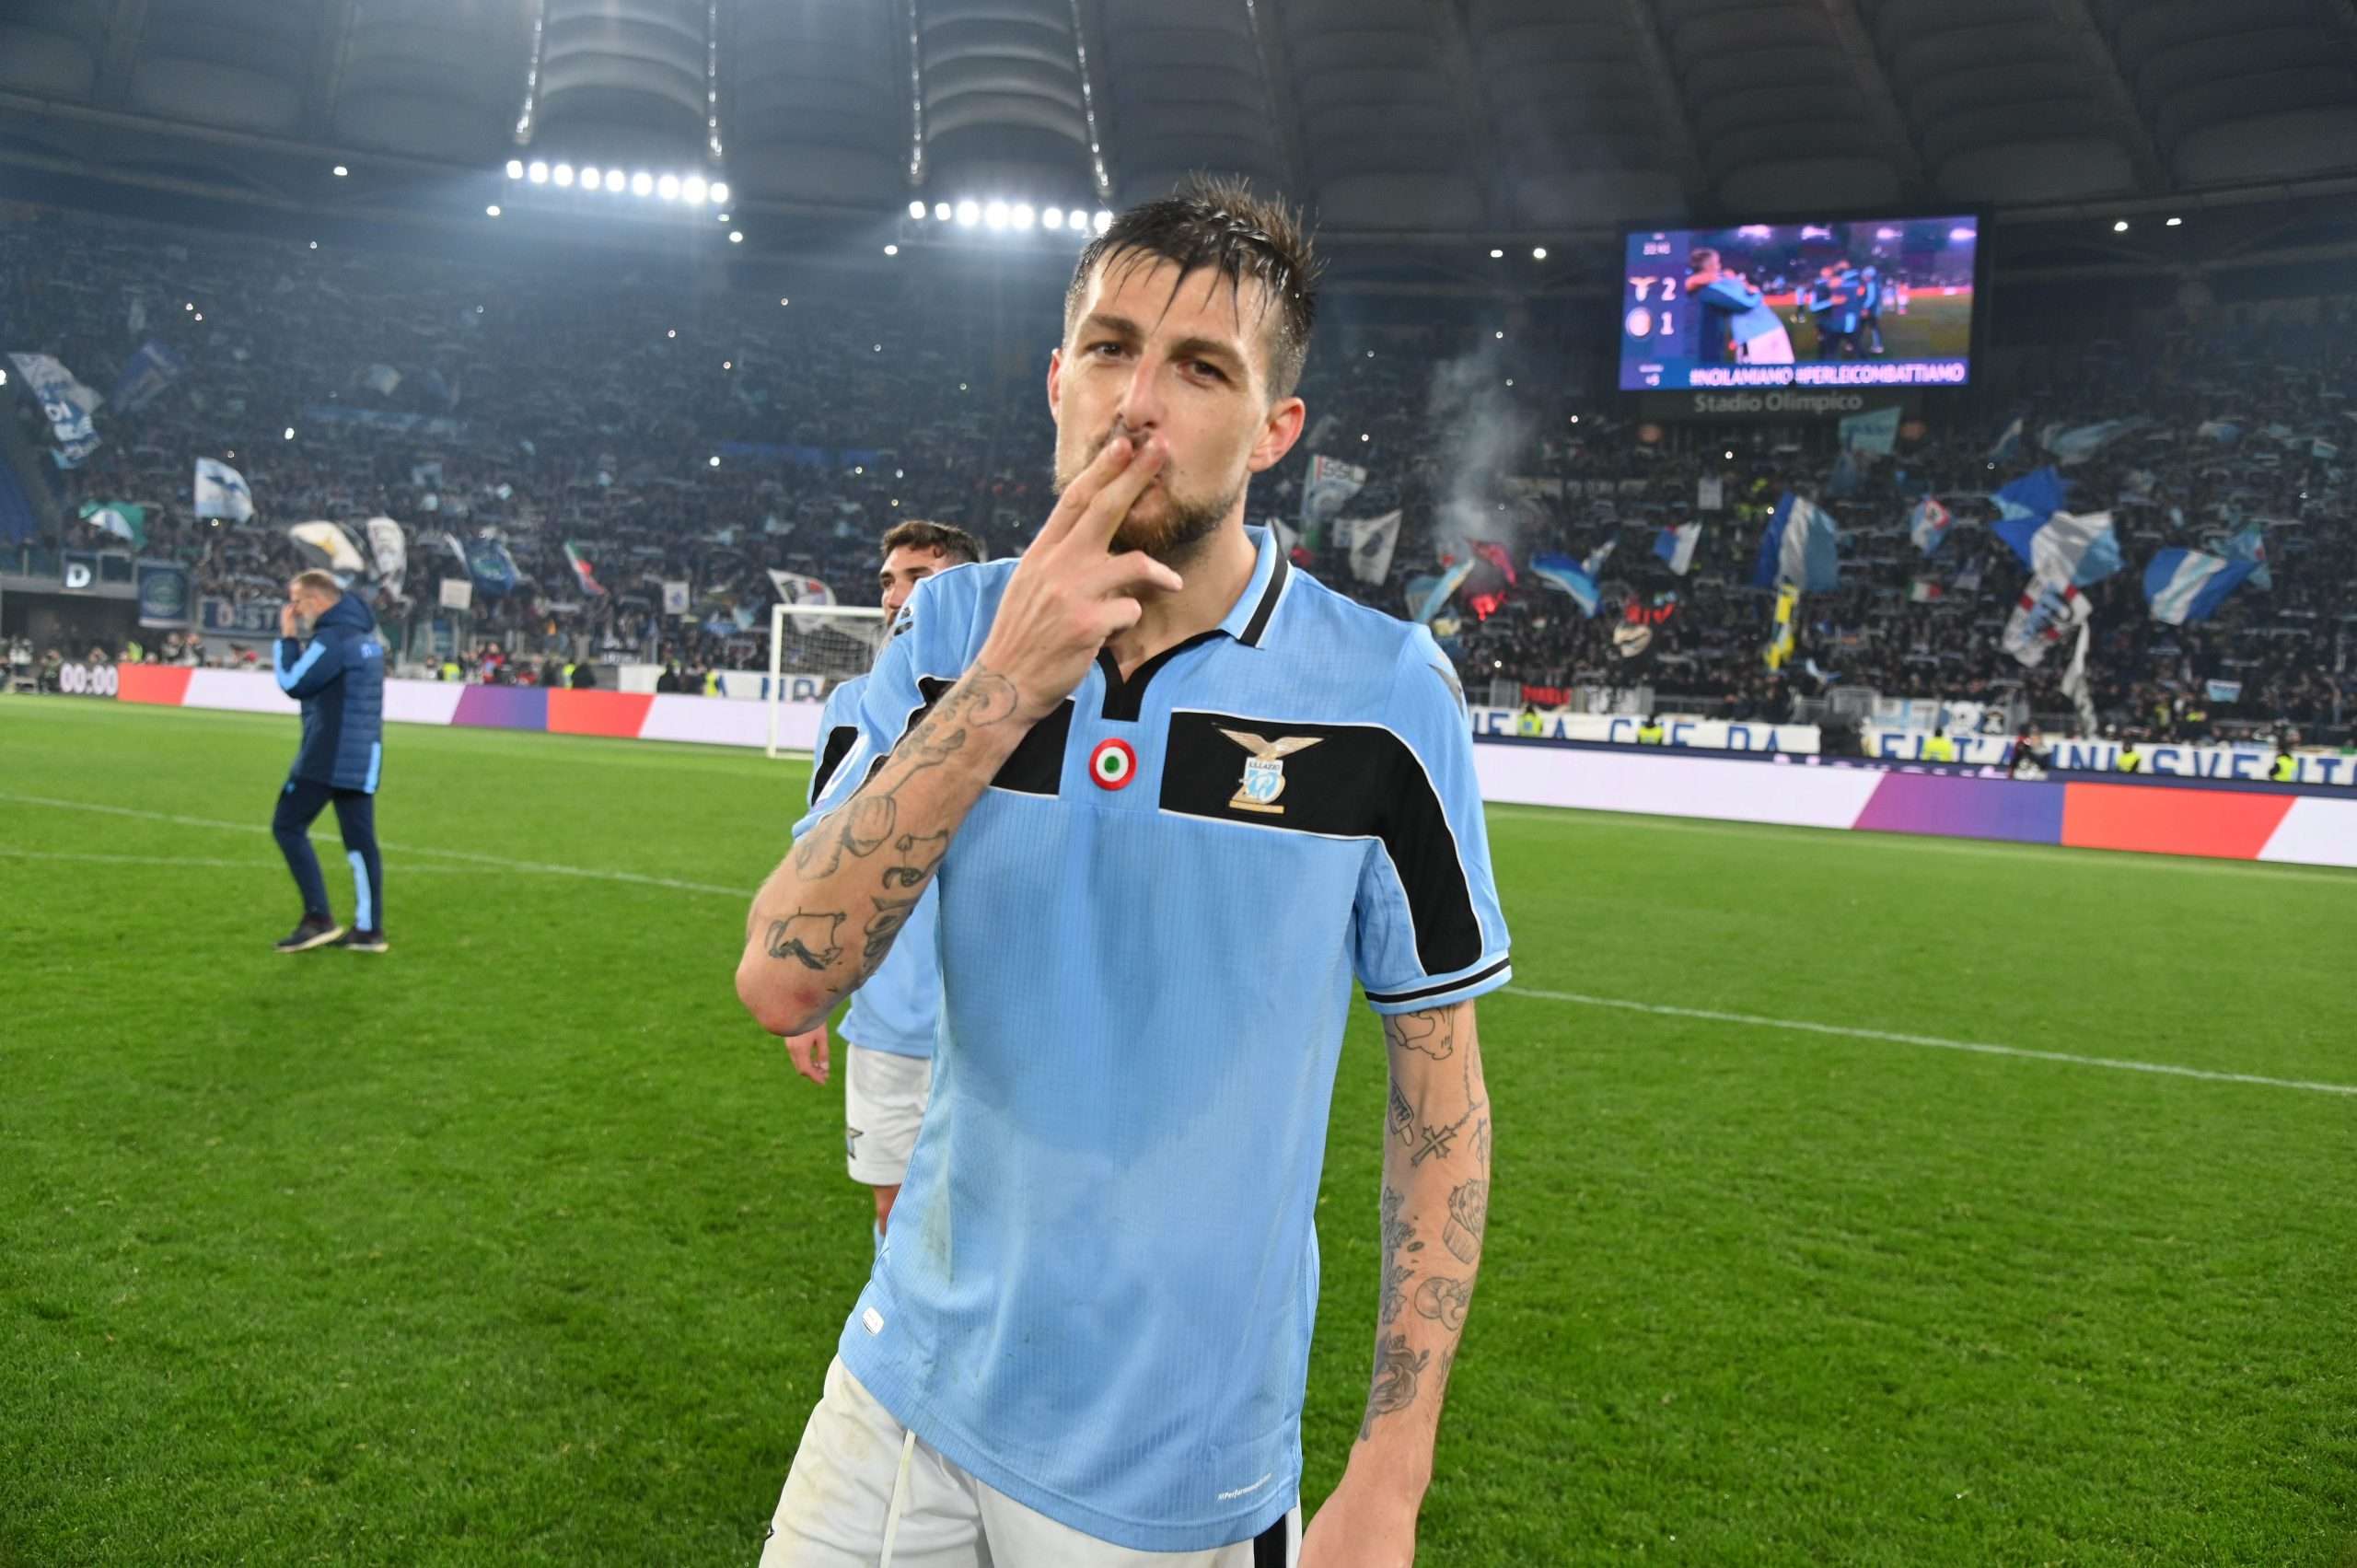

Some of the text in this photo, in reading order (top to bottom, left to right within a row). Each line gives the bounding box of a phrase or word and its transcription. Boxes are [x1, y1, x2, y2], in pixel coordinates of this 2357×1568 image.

[1661, 277, 1676, 301] 2
[1660, 311, 1674, 335] 1
[1693, 390, 1864, 413] Stadio Olimpico
[66, 563, 90, 588] D
[60, 662, 119, 696] 00:00
